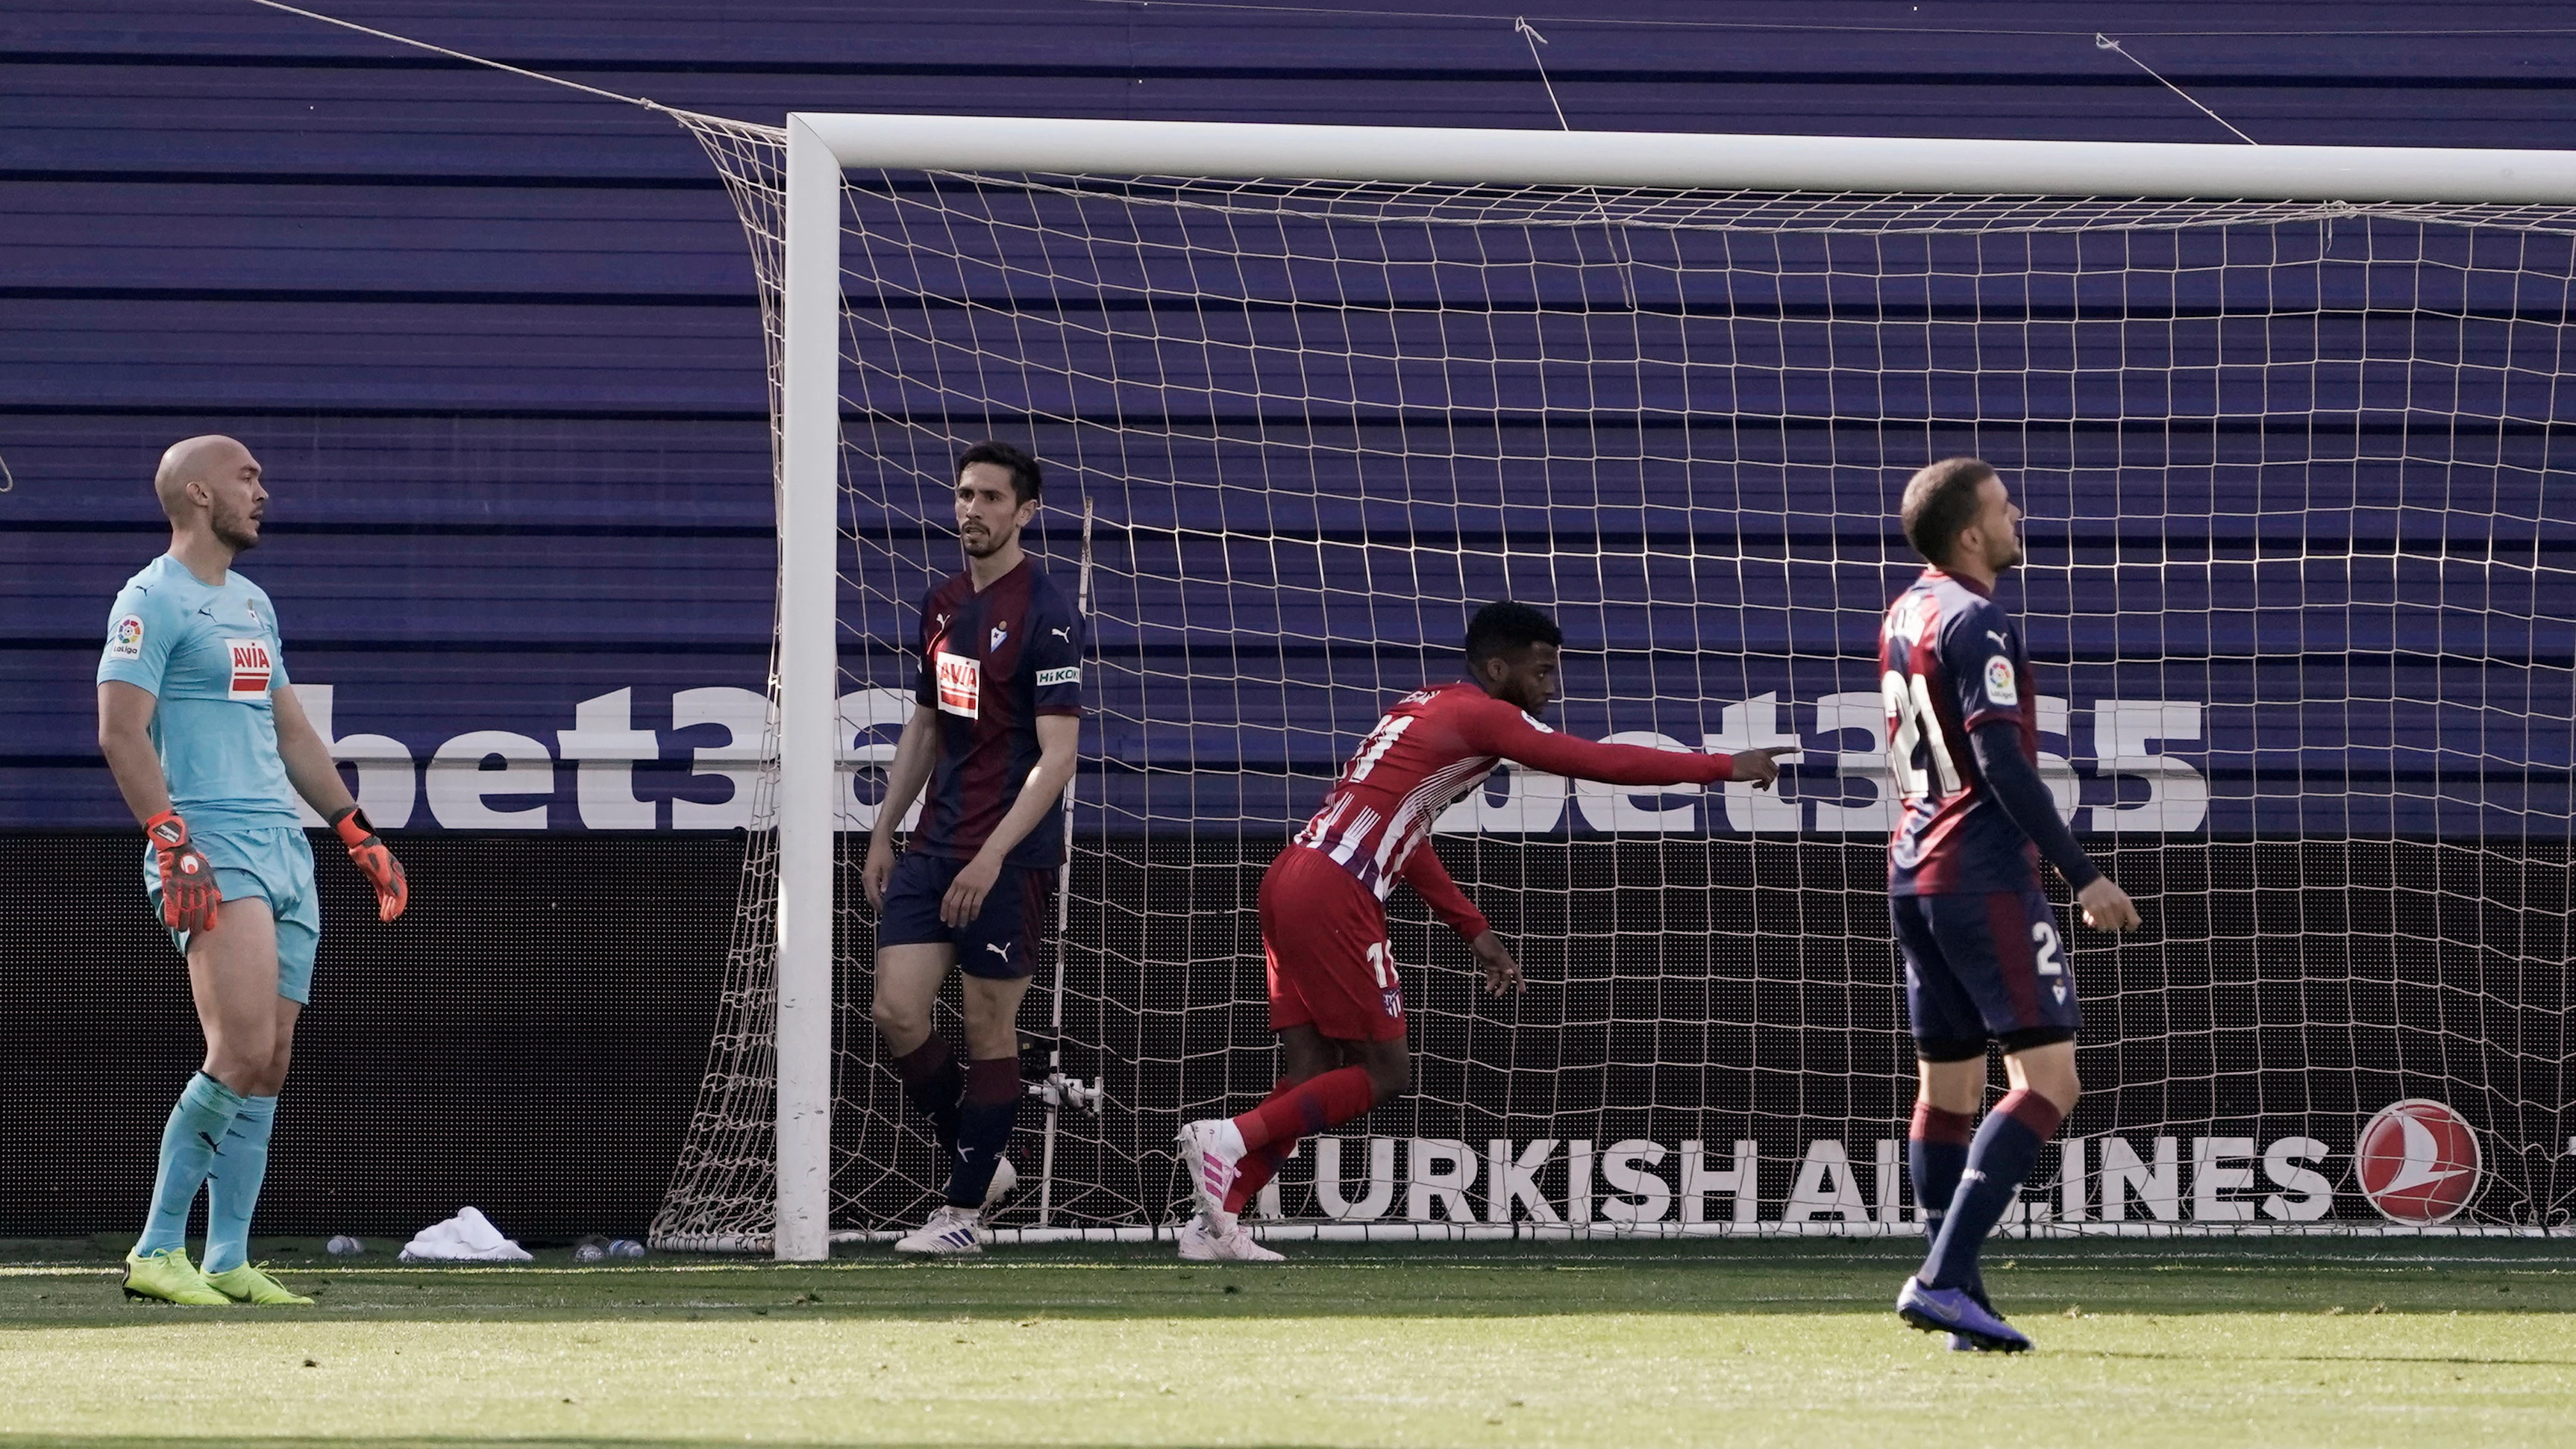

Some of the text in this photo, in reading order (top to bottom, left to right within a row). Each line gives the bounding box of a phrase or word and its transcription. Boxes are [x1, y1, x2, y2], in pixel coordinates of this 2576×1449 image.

[113, 645, 138, 655] LaLiga
[289, 683, 933, 832] bet36
[1881, 670, 1962, 798] 21
[2032, 921, 2072, 976] 2
[1781, 1136, 2333, 1222] AIINES
